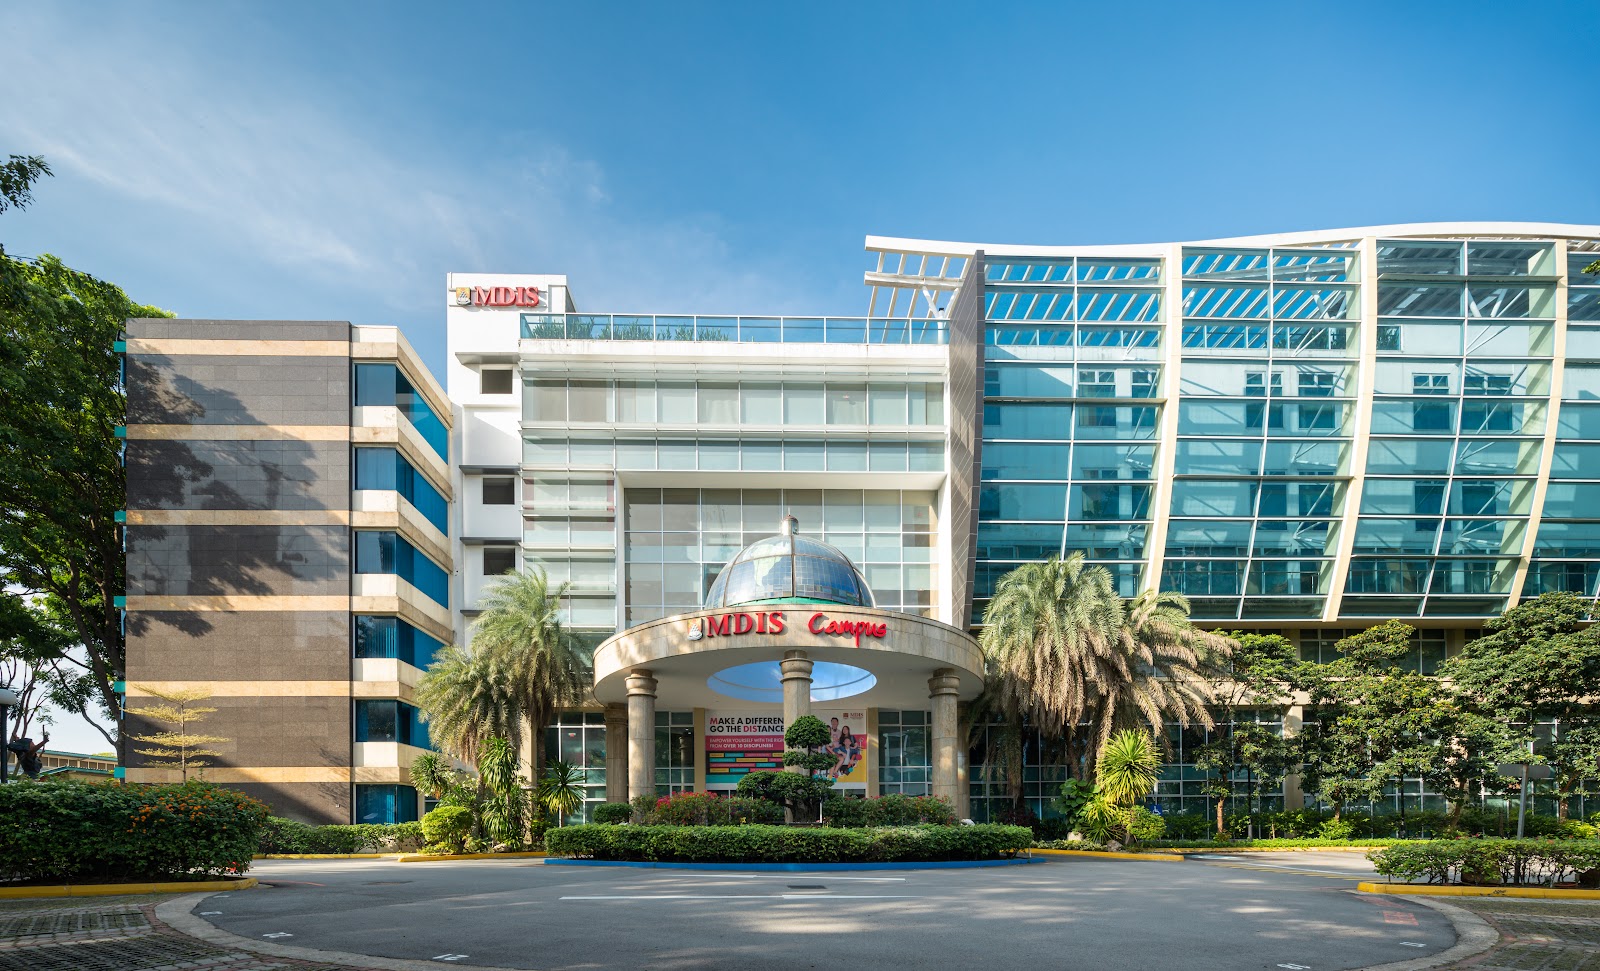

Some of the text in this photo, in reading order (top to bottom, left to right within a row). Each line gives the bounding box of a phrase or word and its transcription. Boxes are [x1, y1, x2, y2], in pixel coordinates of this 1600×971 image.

[474, 286, 539, 307] MDIS
[706, 611, 887, 648] MDIS Campus
